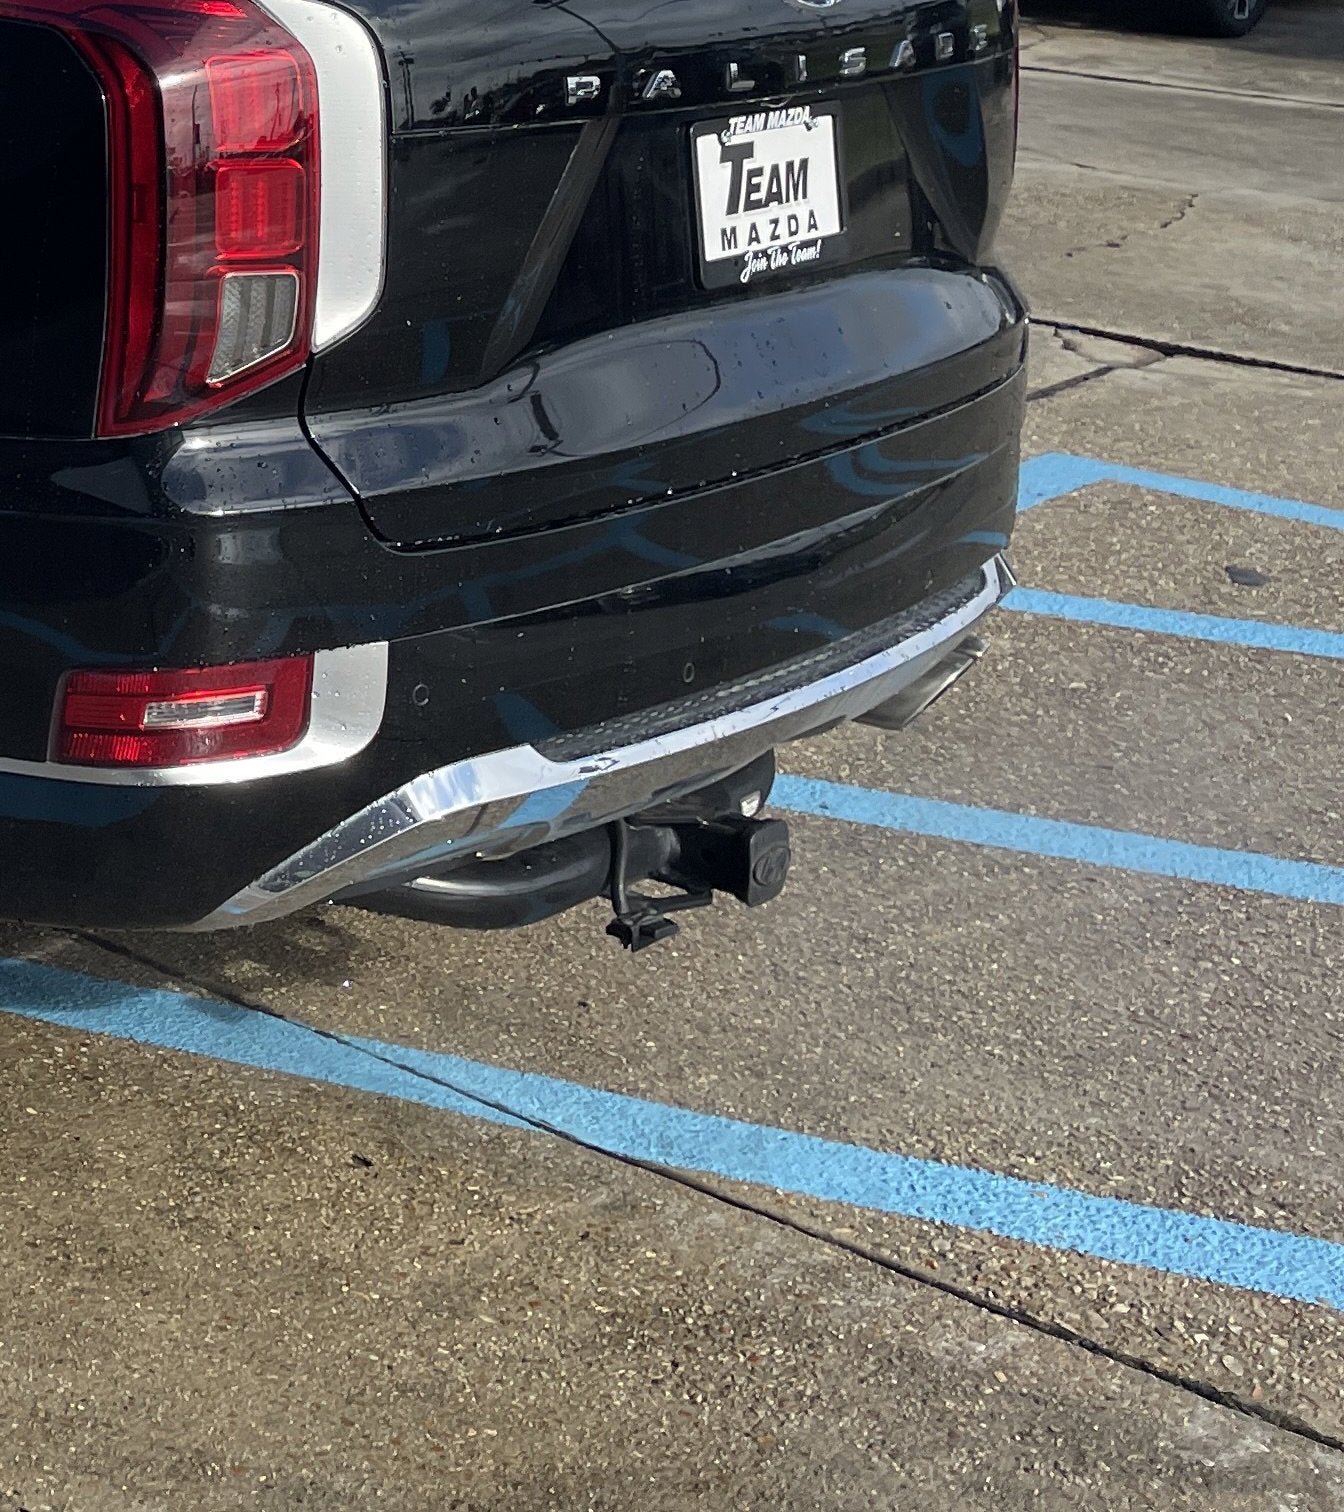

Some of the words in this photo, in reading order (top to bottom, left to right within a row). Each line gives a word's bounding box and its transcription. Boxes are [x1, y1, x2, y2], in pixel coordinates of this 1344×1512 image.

[566, 24, 989, 106] PALISADE
[729, 113, 766, 136] TEAM
[767, 106, 811, 130] MAZDA
[720, 141, 809, 216] TEAM
[720, 209, 819, 252] MAZDA
[740, 250, 769, 284] Join
[768, 246, 789, 270] The
[789, 239, 823, 265] Team!
